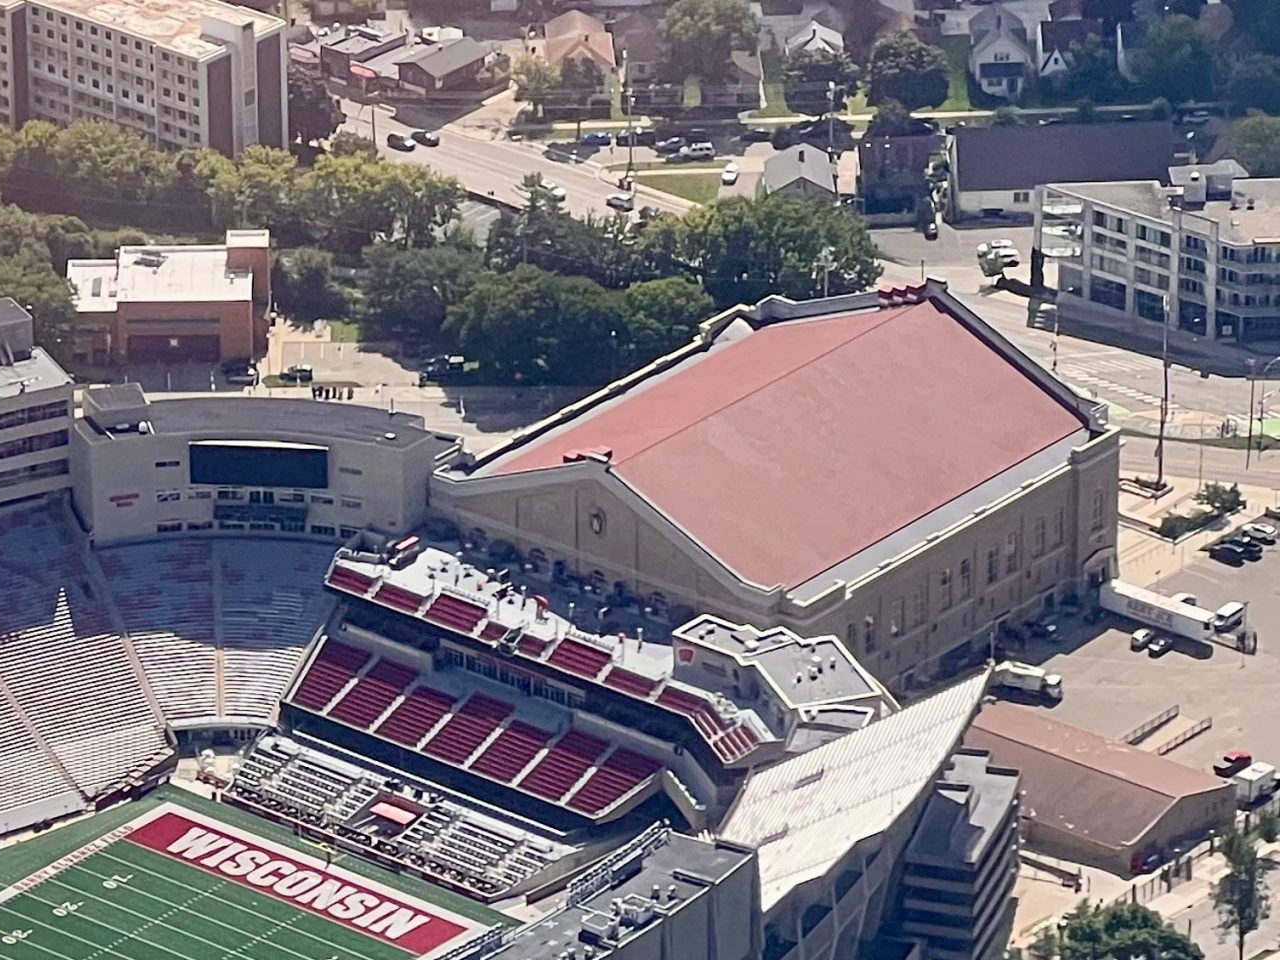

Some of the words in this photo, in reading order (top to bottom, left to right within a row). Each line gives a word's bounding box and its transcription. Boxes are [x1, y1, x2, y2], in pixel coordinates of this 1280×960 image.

[167, 826, 431, 939] WISCONSIN
[52, 901, 78, 917] 20
[2, 929, 28, 944] 30
